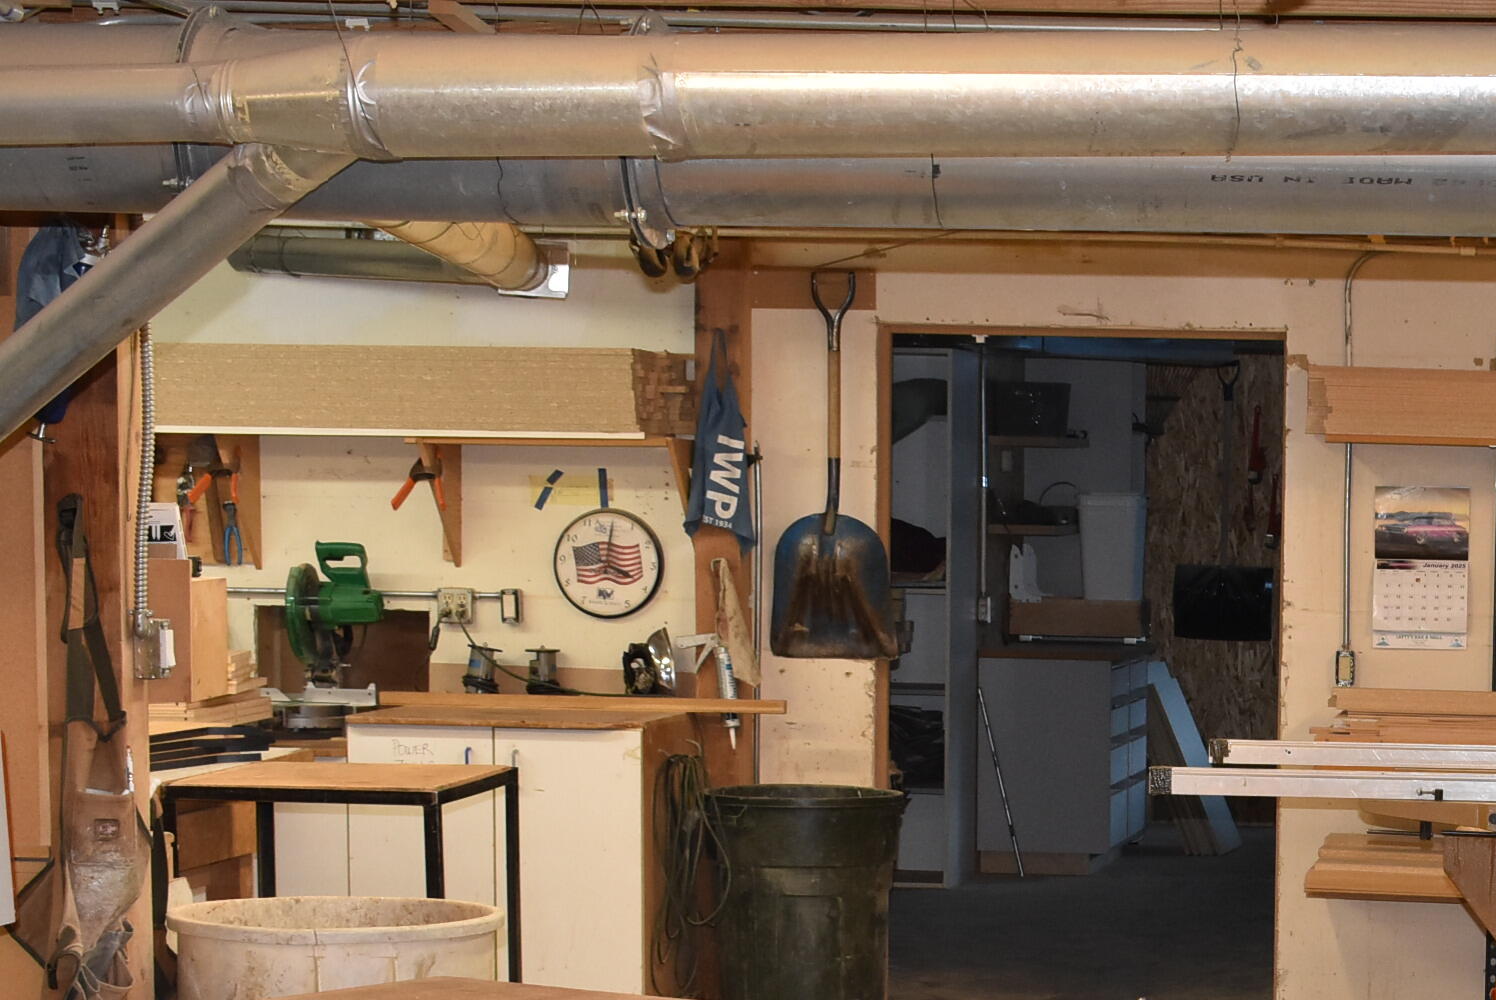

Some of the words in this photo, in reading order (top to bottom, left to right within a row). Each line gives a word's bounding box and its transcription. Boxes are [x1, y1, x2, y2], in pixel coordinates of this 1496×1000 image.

[1210, 174, 1265, 183] USA
[706, 434, 745, 519] IWP
[715, 519, 733, 529] 1934
[392, 739, 434, 757] POWER
